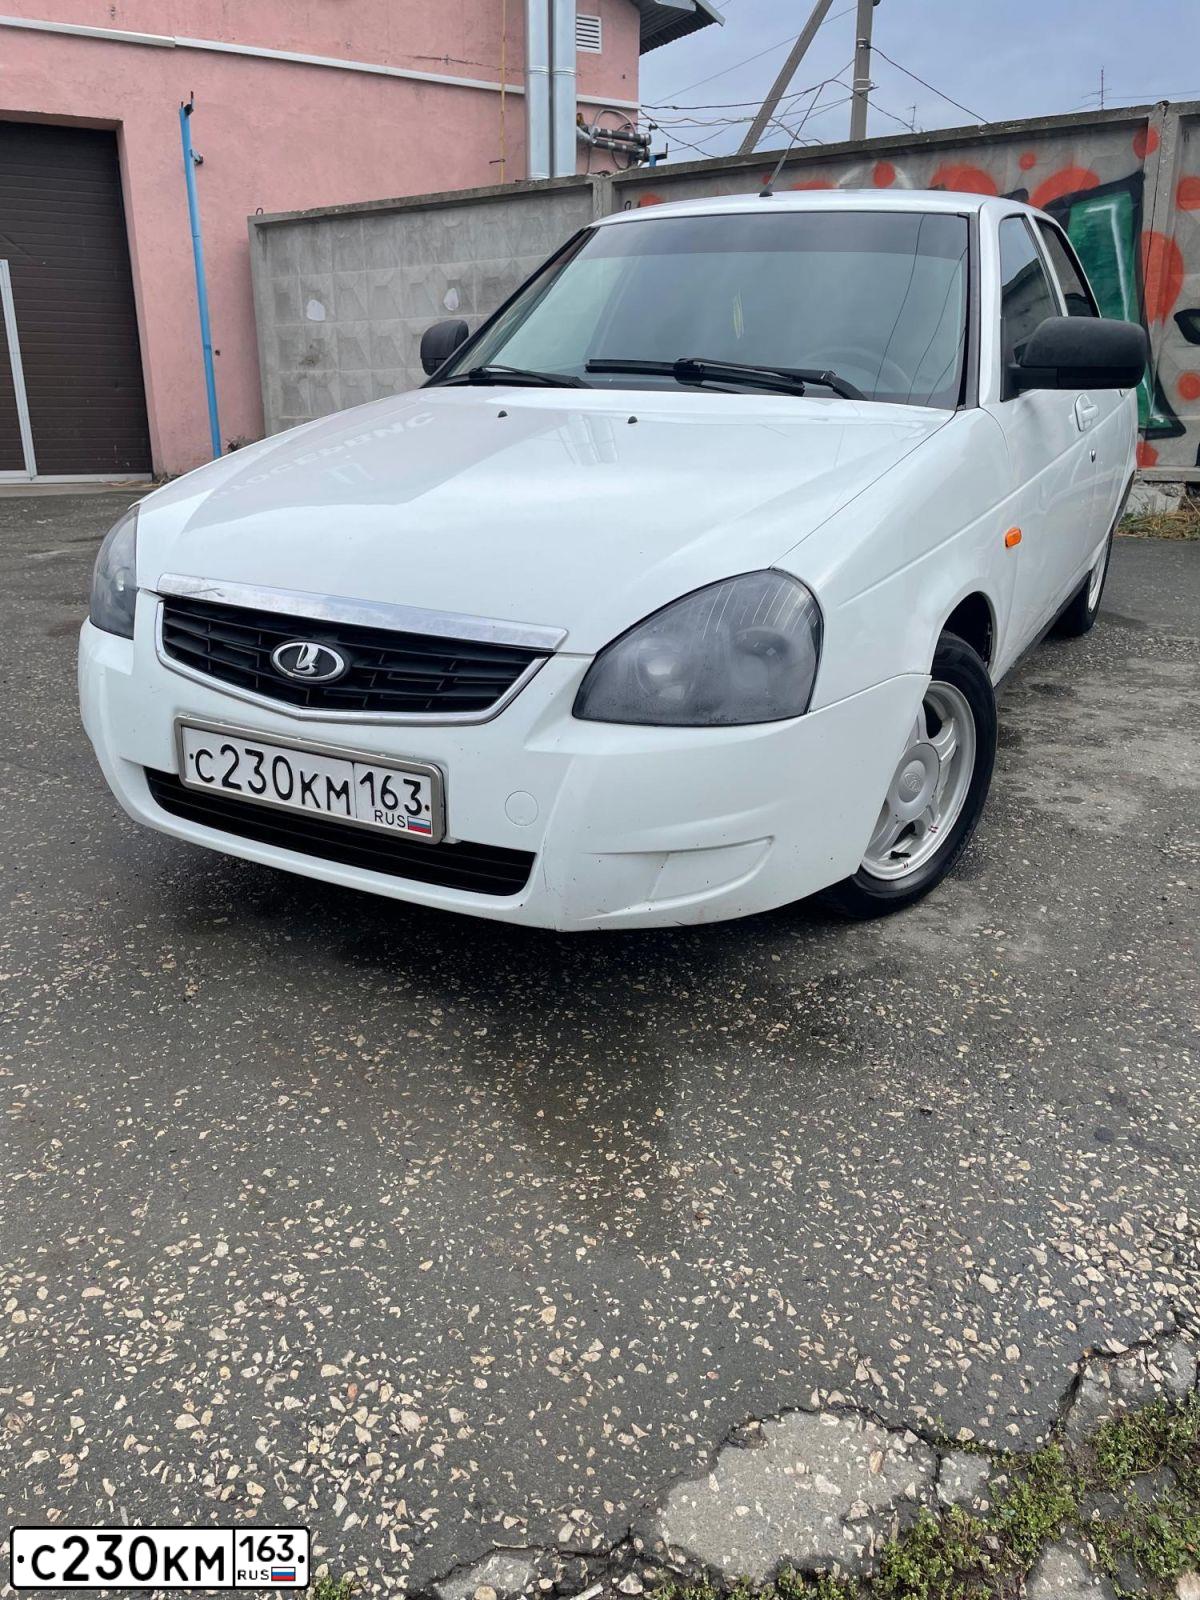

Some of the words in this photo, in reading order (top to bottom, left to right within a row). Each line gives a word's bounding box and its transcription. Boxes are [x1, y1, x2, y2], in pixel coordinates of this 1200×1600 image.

[195, 744, 350, 815] С230КМ
[360, 772, 423, 816] 163
[375, 810, 406, 828] RUS
